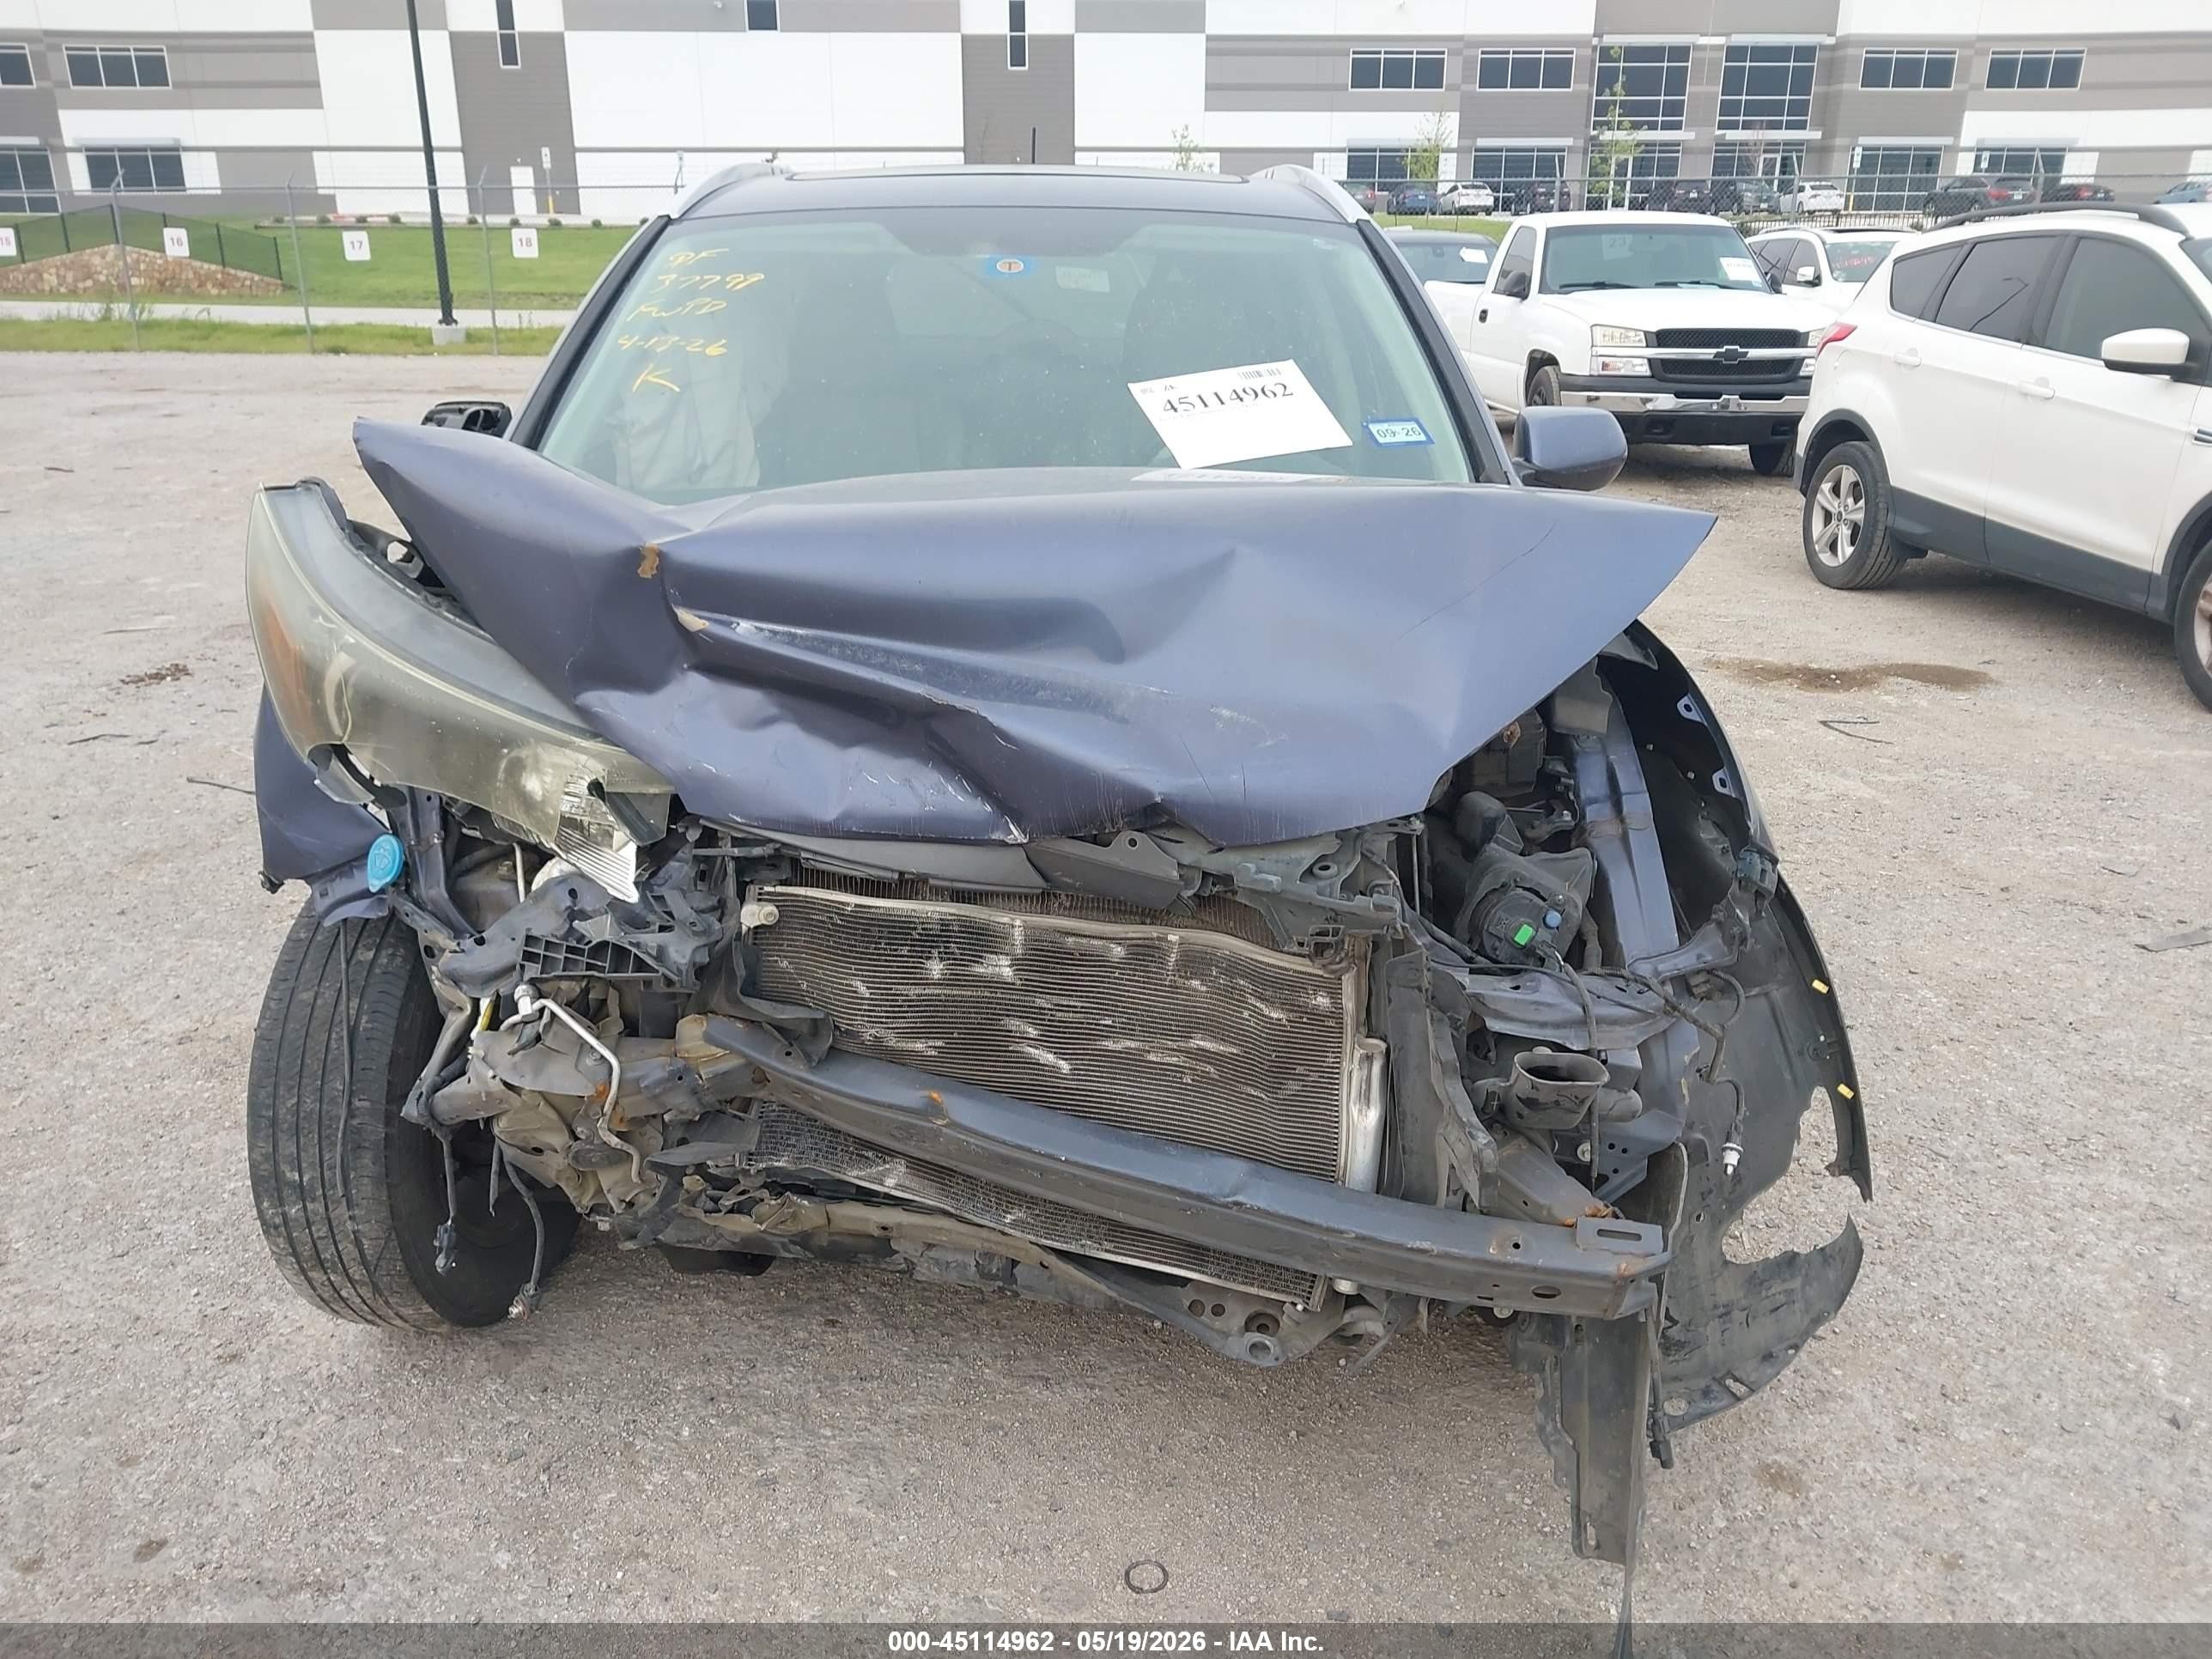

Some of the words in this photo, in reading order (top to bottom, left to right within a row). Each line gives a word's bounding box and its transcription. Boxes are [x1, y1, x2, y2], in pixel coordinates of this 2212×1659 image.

[0, 236, 11, 246] 15
[170, 237, 184, 247] 16
[349, 240, 363, 251] 17
[519, 238, 532, 248] 18
[632, 363, 681, 392] K
[1164, 383, 1293, 413] 45114962
